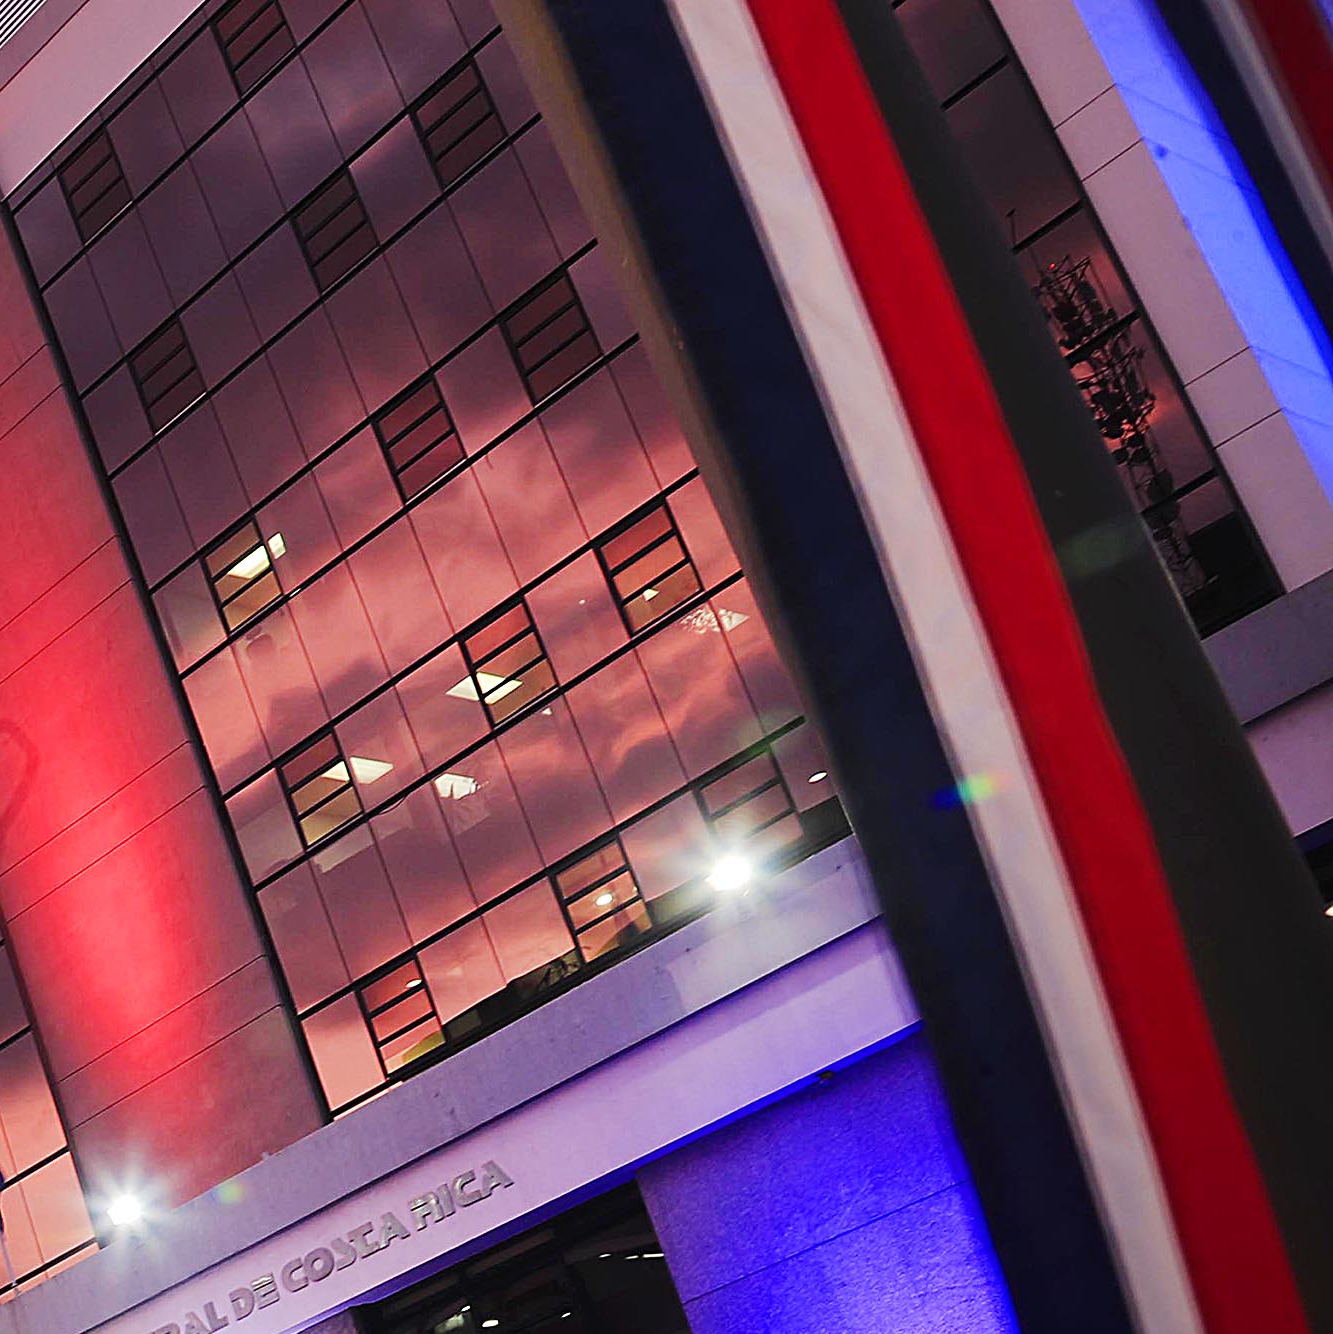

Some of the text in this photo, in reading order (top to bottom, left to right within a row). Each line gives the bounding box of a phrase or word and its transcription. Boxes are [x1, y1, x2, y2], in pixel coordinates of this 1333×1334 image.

[228, 1271, 281, 1321] DE
[282, 1211, 412, 1293] COSTA
[407, 1159, 515, 1232] RICA
